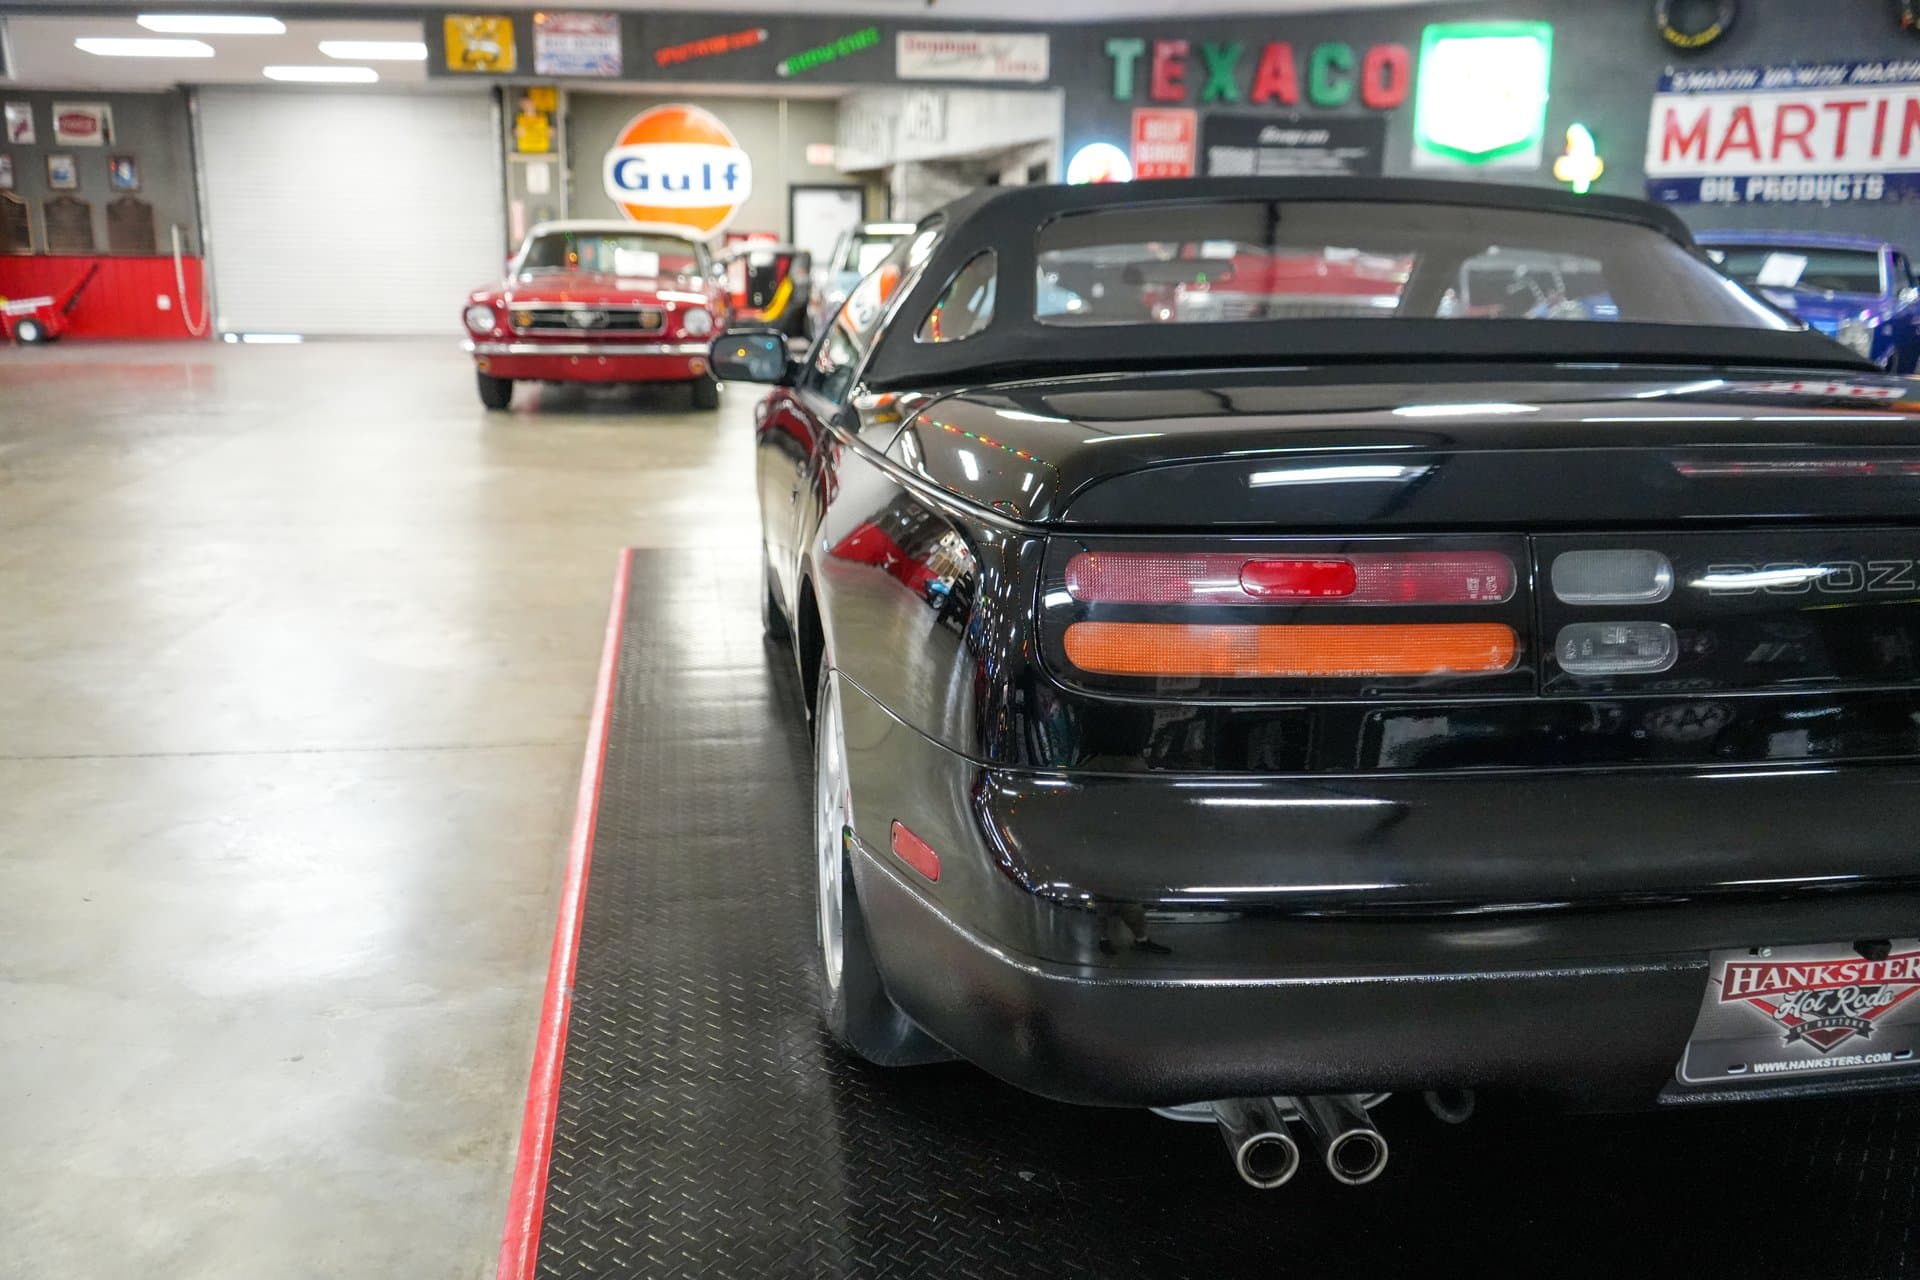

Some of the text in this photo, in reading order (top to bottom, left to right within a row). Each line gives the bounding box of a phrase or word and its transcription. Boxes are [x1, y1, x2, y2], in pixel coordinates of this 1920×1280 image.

[1105, 37, 1411, 109] TEXACO
[613, 156, 739, 191] Gulf
[1700, 173, 1885, 202] OIL PRODUCTS
[1773, 984, 1894, 1020] Hot Rods
[1753, 1052, 1892, 1073] WWW.HANKSTERS.COM
